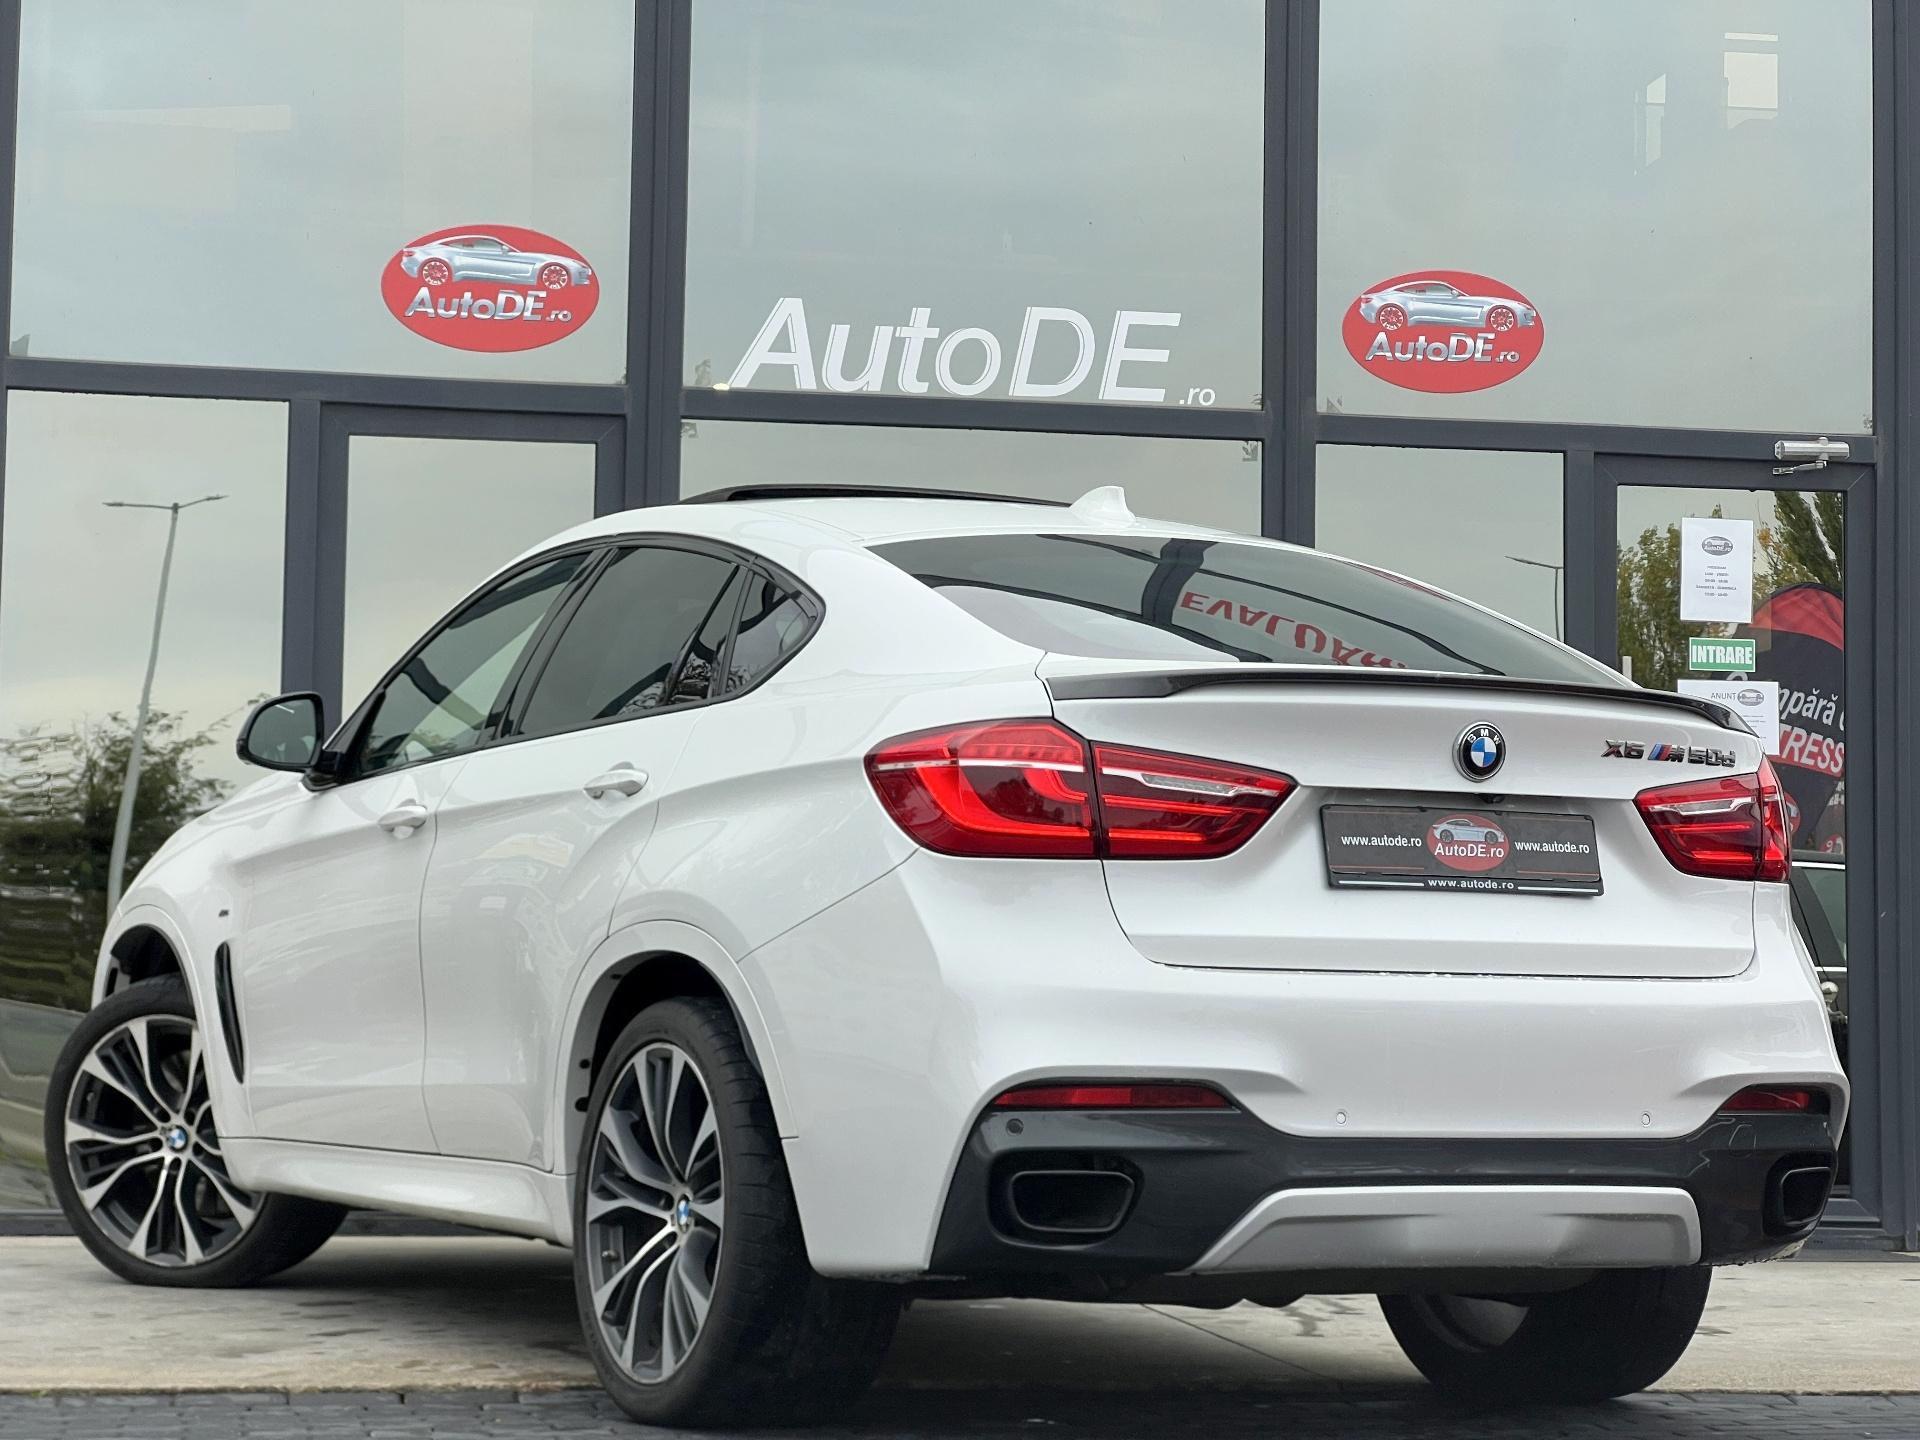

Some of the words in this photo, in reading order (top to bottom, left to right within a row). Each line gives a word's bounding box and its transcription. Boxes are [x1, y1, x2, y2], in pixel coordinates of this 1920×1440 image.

[1691, 644, 1753, 665] INTRARE
[1467, 729, 1501, 745] BMW
[1601, 739, 1645, 759] X6
[1779, 722, 1845, 773] TRESS
[1341, 834, 1422, 848] www.autode.ro
[1515, 839, 1590, 855] www.autode.ro
[1434, 842, 1505, 859] AutoDE.ro
[1428, 878, 1515, 891] www.autode.ro
